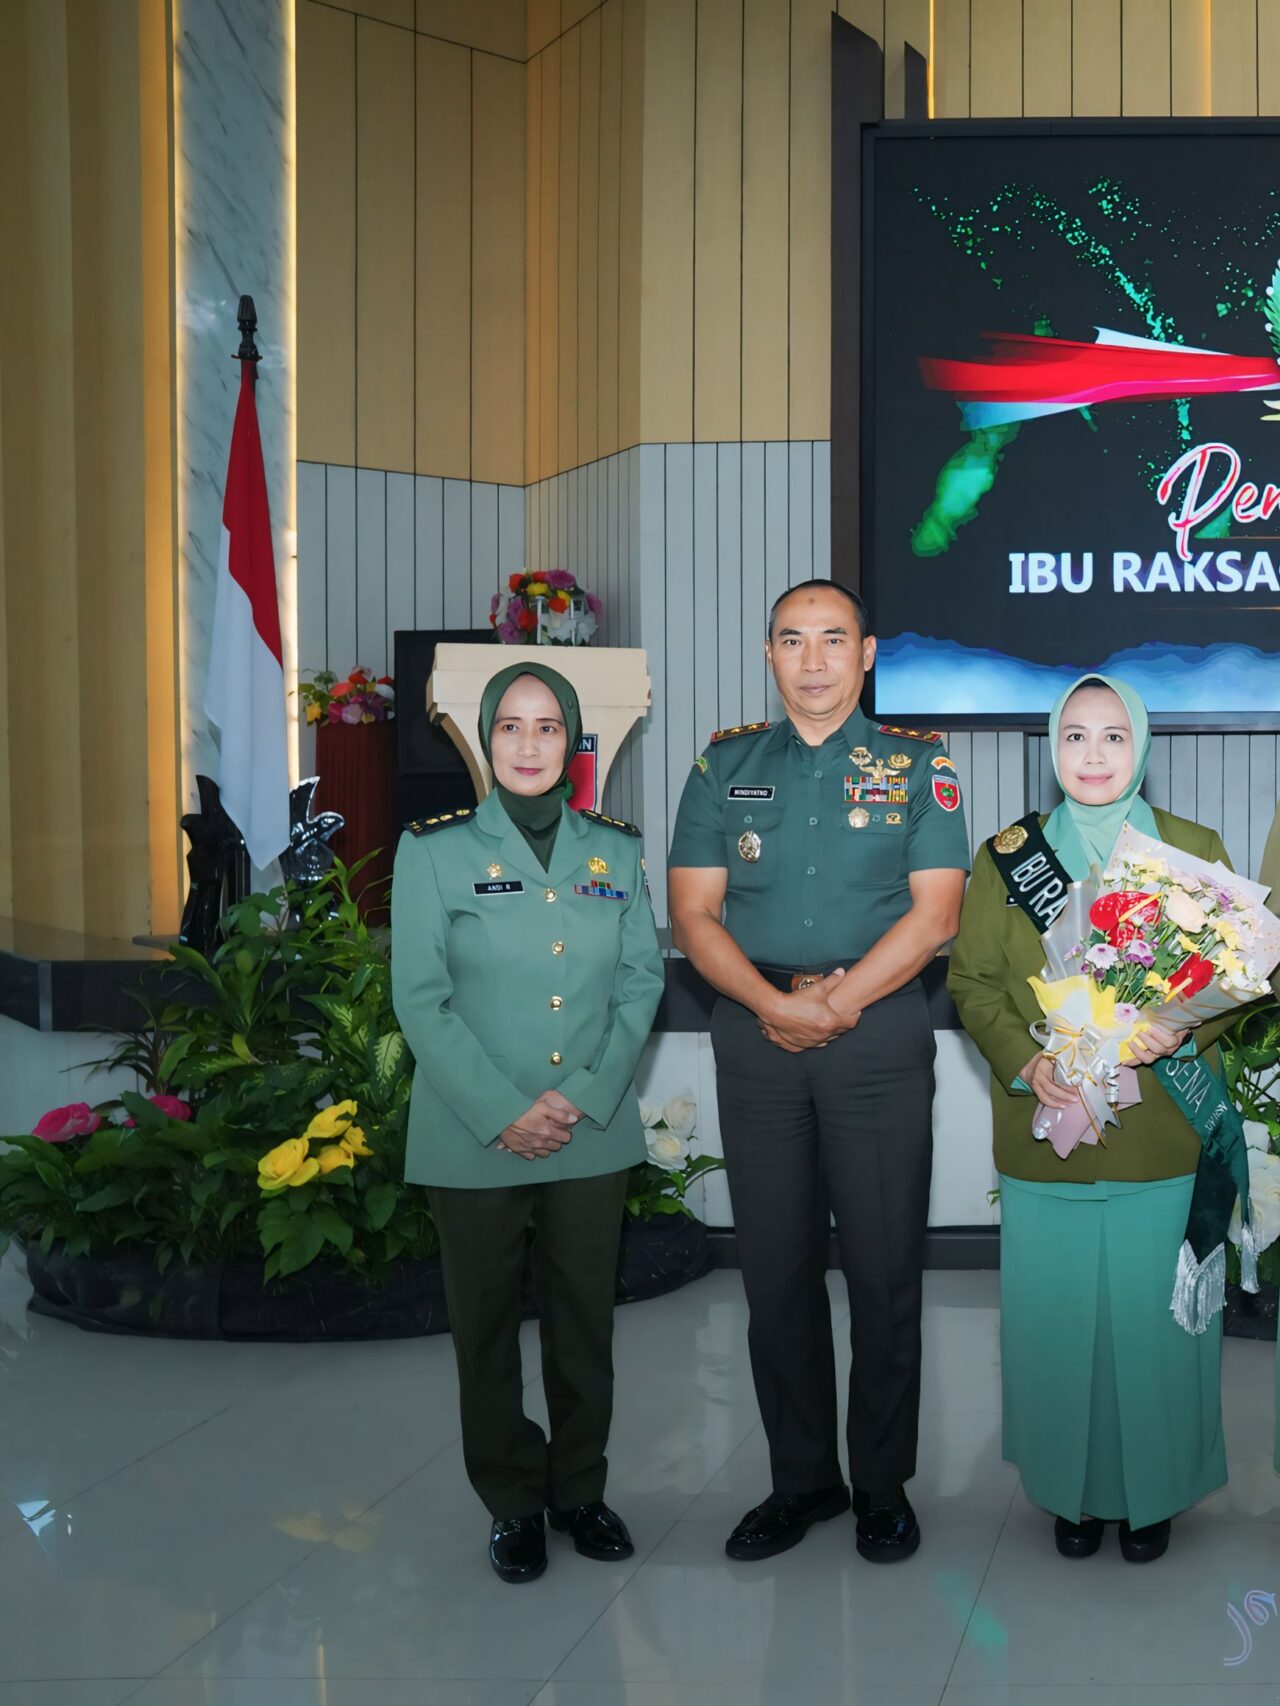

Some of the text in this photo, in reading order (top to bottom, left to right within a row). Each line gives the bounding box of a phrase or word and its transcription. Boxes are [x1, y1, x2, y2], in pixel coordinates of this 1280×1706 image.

[1008, 551, 1094, 594] IBU
[1112, 550, 1280, 593] RAKSA
[1010, 851, 1069, 928] IBU RA
[1165, 1059, 1212, 1114] SENA
